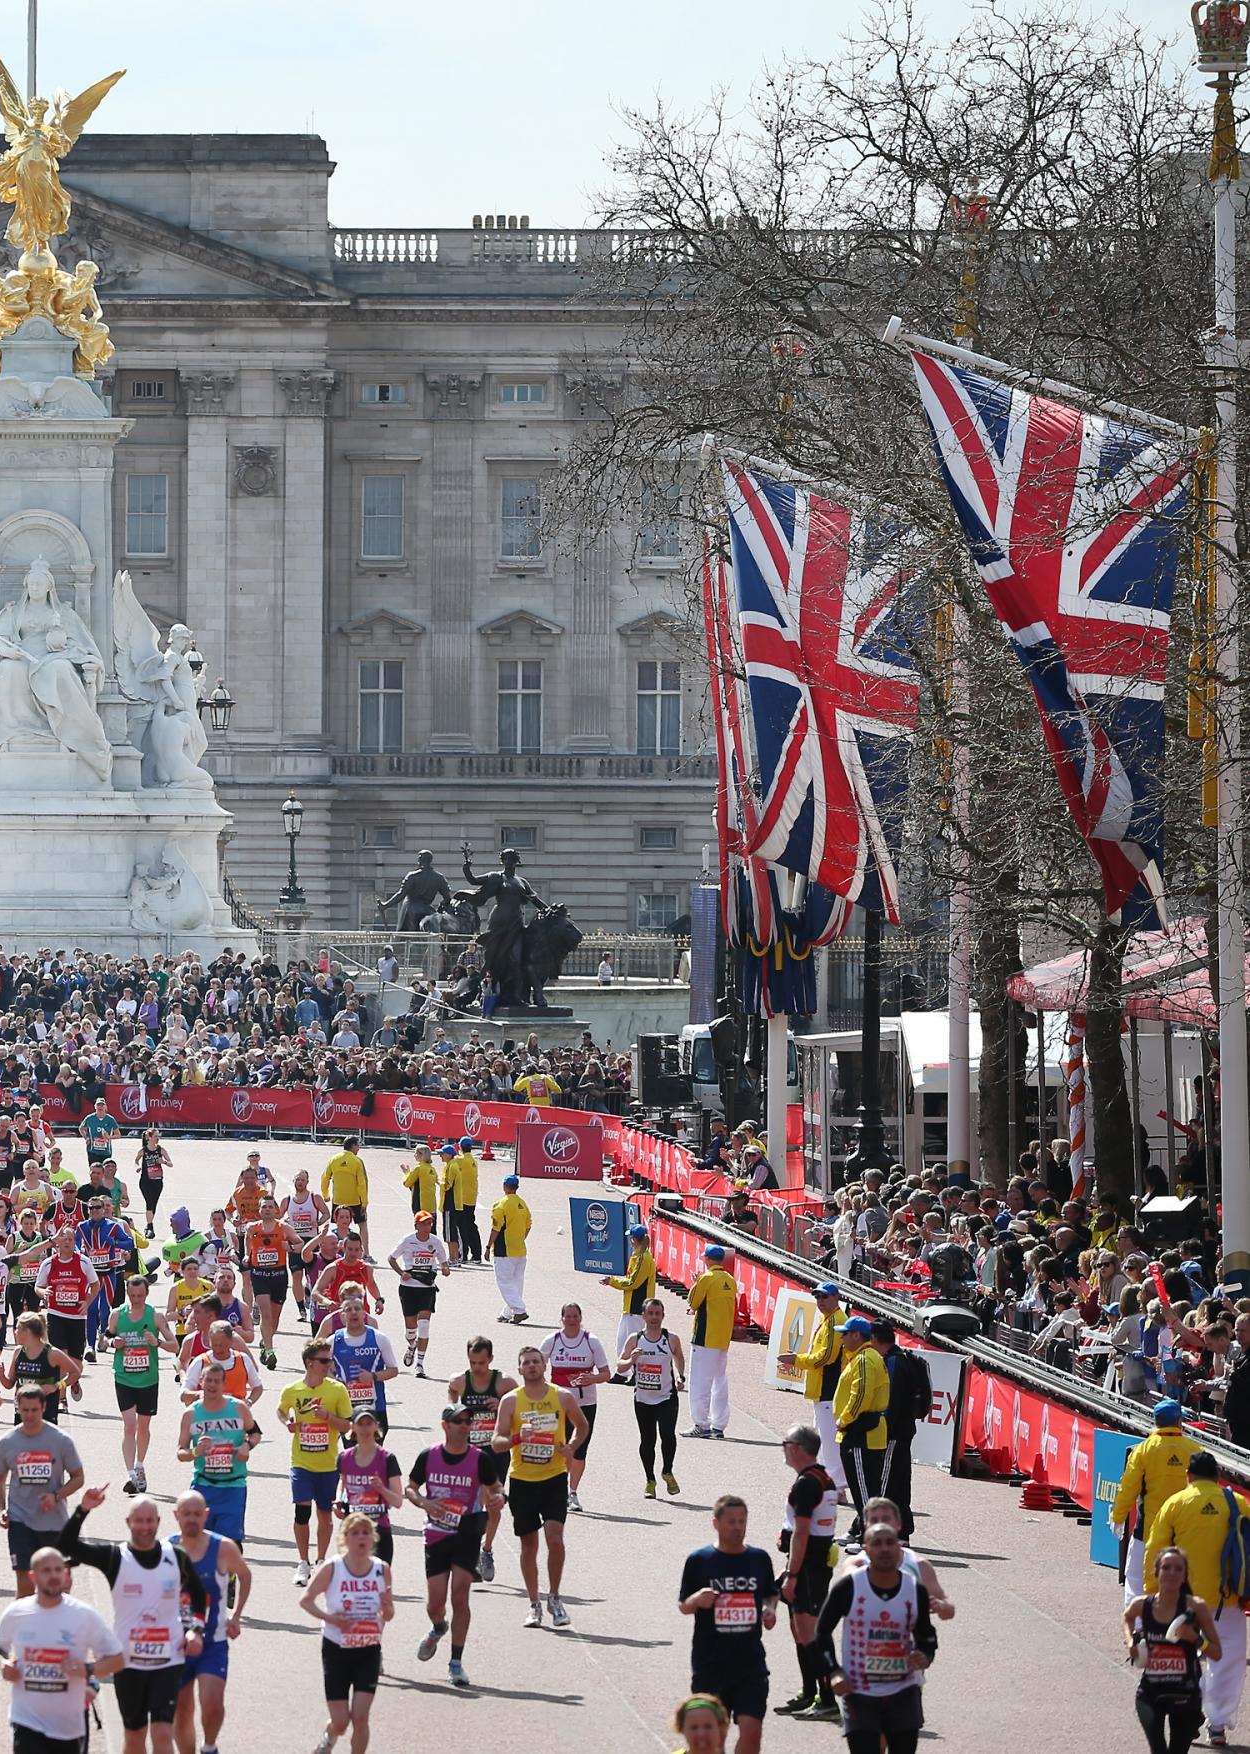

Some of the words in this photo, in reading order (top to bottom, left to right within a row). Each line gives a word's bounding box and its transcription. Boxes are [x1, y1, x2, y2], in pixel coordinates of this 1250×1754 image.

[42, 1097, 66, 1109] oney
[150, 1096, 183, 1111] money
[253, 1102, 277, 1113] money
[336, 1103, 361, 1115] money
[414, 1110, 435, 1123] money
[481, 1115, 500, 1128] money
[548, 1132, 577, 1157] Virgin
[544, 1164, 580, 1176] money
[354, 1347, 377, 1356] SCOTT
[124, 1356, 147, 1366] 42131
[300, 1433, 328, 1443] 54938
[19, 1464, 50, 1475] 11256
[429, 1473, 472, 1487] ALISTAIR
[340, 1581, 379, 1592] AILSA
[710, 1577, 758, 1591] INEOS
[717, 1608, 755, 1622] 44312
[134, 1643, 165, 1655] 8427
[1150, 1660, 1184, 1673] 0840
